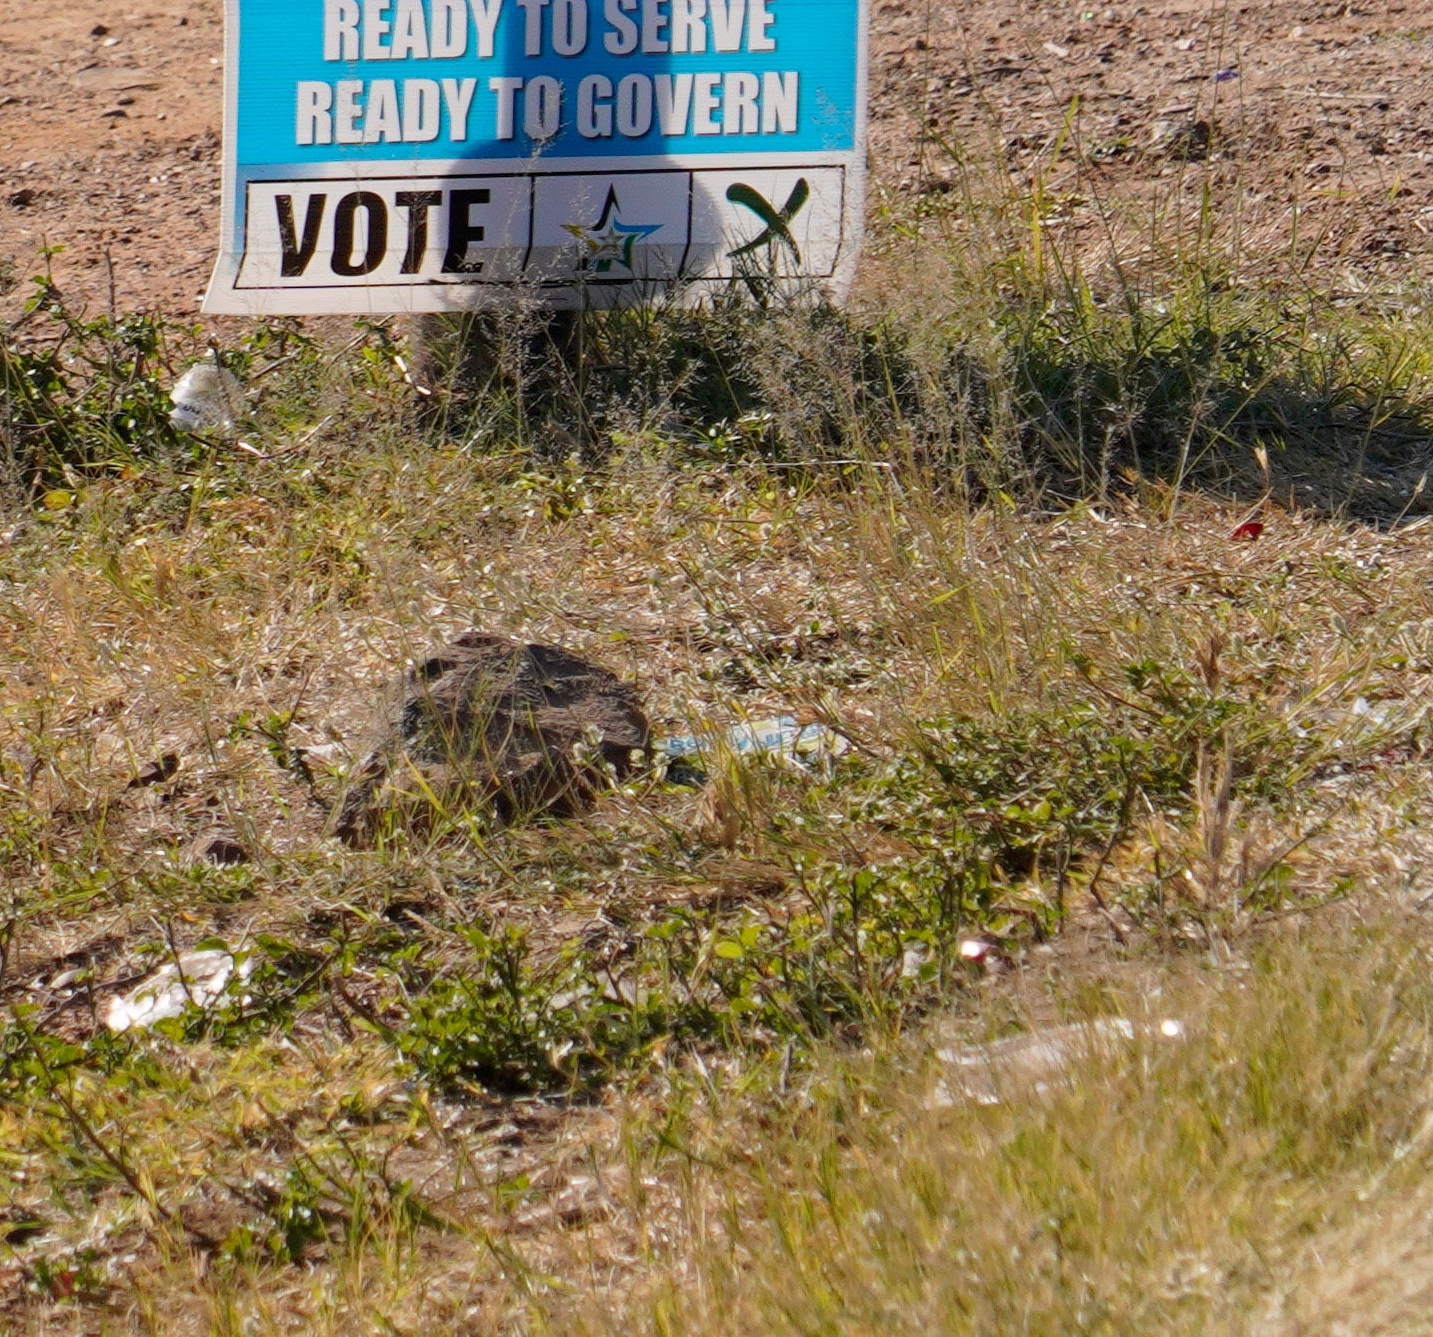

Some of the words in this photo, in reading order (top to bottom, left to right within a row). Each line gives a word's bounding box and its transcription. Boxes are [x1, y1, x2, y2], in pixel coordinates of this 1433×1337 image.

[295, 76, 478, 147] READY
[489, 74, 565, 142] TO
[576, 70, 800, 140] GOVERN
[272, 187, 491, 278] VOTE
